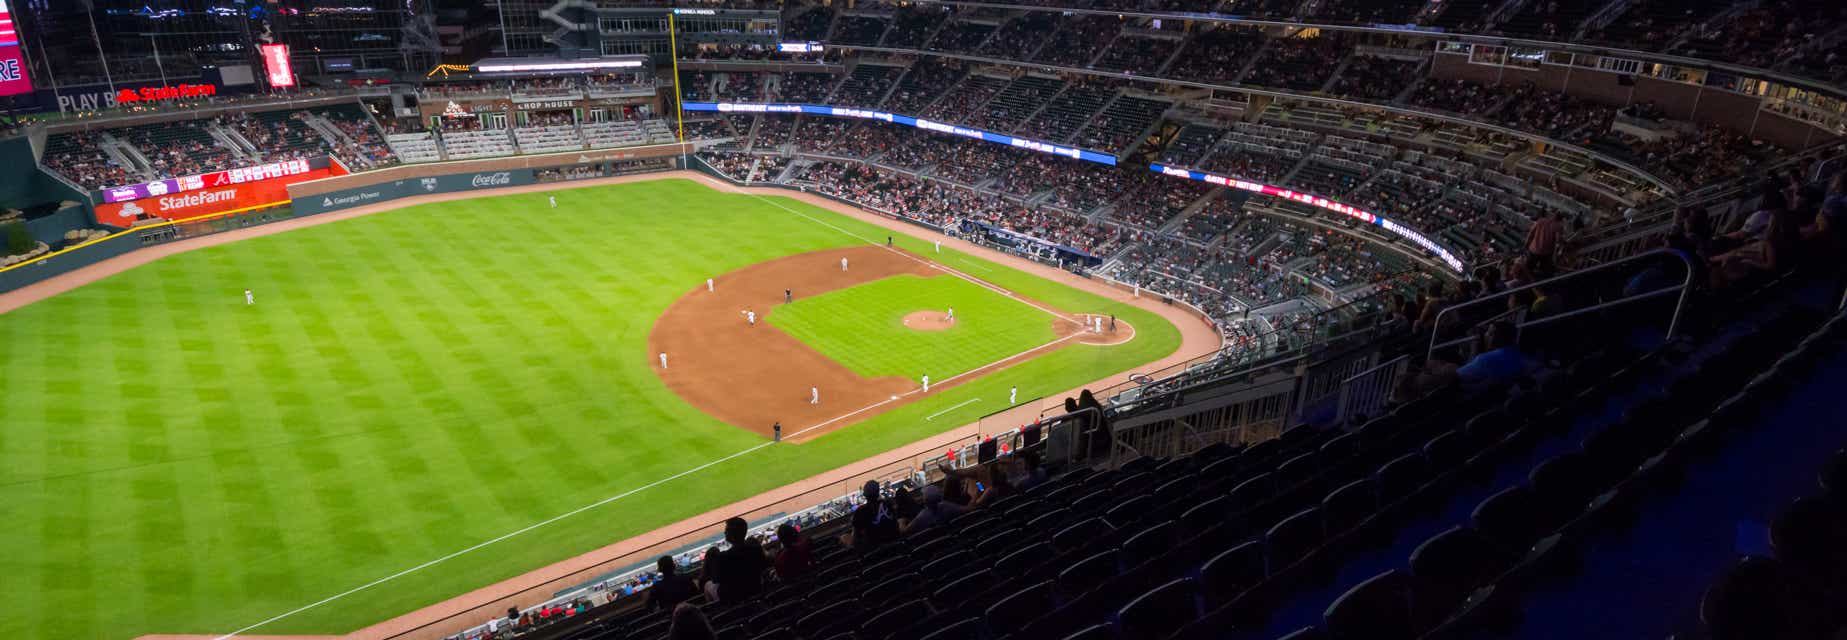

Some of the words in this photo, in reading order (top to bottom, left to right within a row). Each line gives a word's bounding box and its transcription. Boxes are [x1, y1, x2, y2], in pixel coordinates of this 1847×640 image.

[58, 93, 98, 113] PLAY
[159, 189, 236, 211] StateFarm
[334, 195, 360, 205] Georgia
[360, 191, 379, 200] Power
